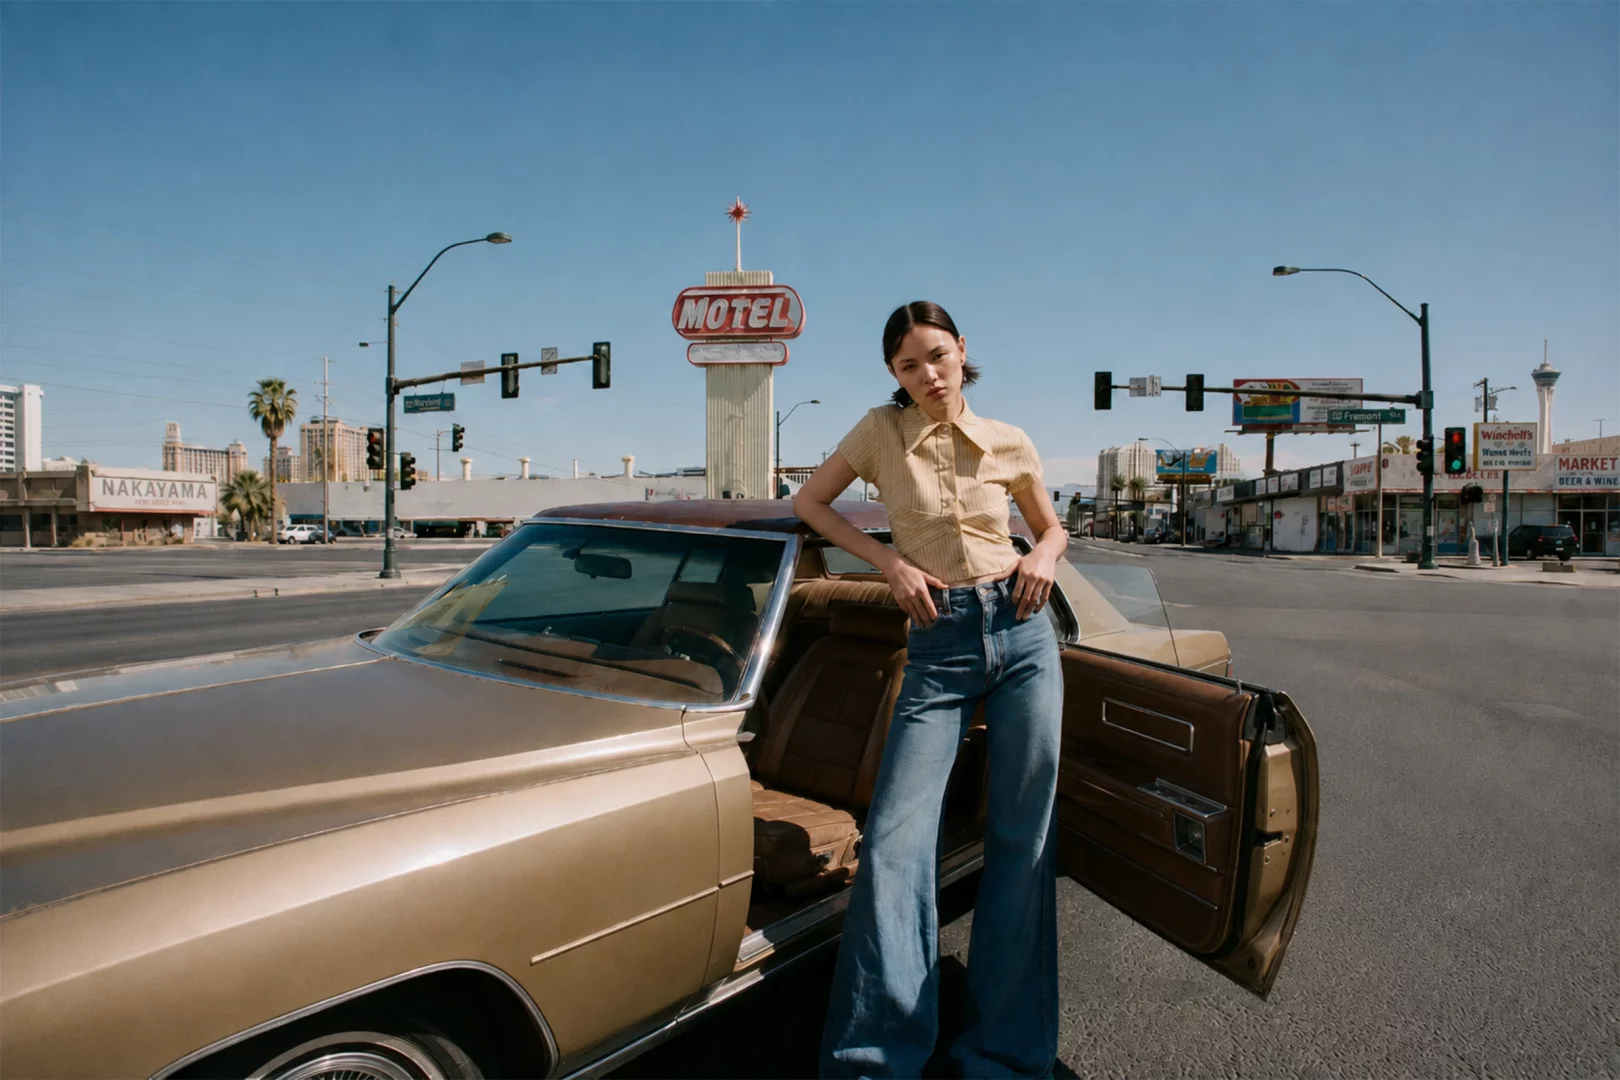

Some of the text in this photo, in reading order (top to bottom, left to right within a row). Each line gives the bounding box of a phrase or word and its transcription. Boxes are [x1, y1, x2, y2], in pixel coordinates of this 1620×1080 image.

[678, 297, 789, 330] MOTEL
[1344, 412, 1382, 420] Fremont
[1559, 457, 1619, 470] MARKET
[1594, 477, 1619, 485] WINE
[102, 479, 207, 499] NAKAYAMA
